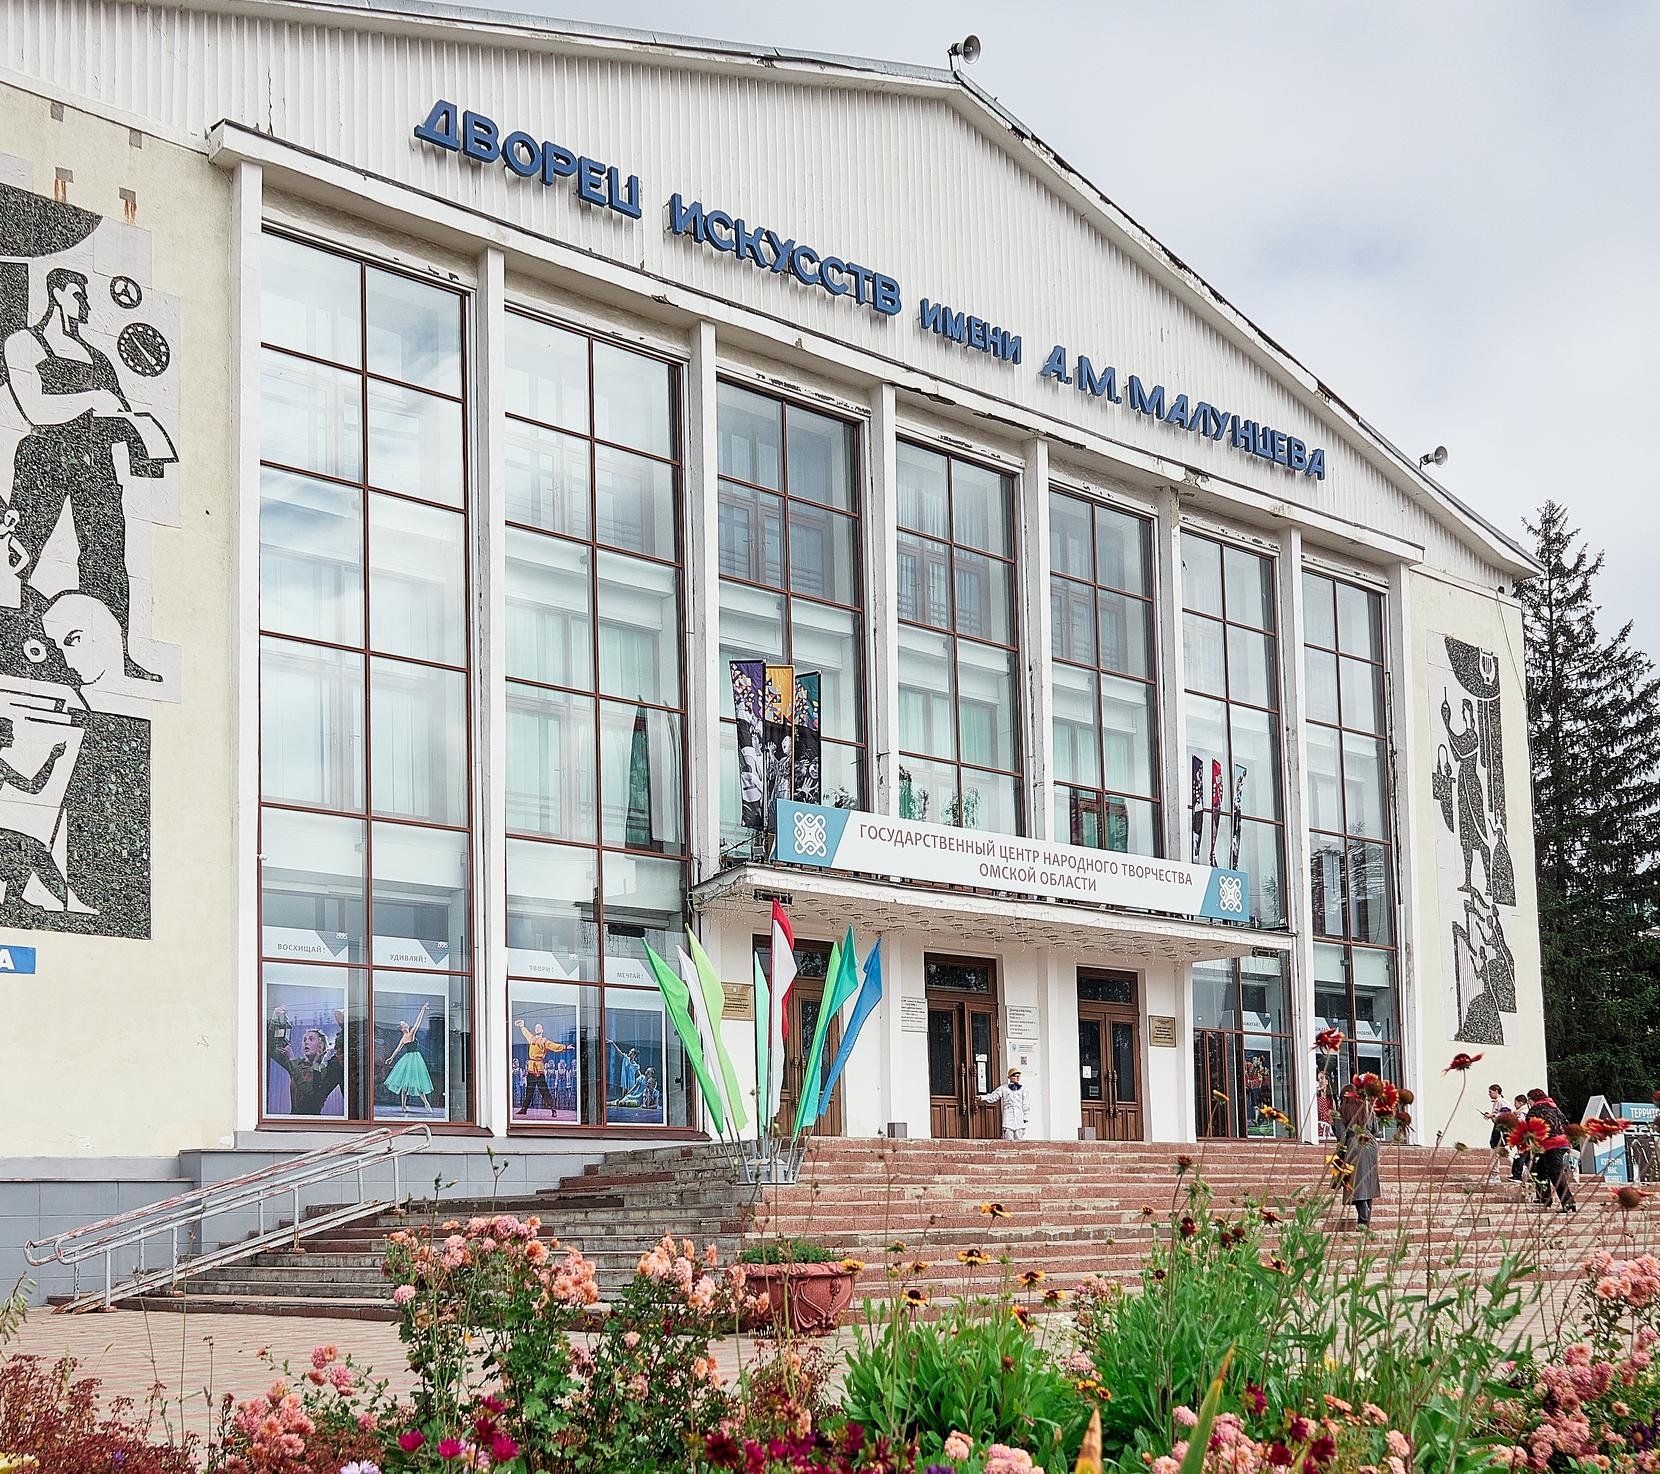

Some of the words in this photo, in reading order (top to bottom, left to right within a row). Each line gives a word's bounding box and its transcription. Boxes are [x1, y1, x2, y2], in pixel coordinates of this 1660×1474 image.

[414, 99, 642, 220] ДВОРЕЦ
[670, 193, 901, 316] ИСКУССТВ
[919, 297, 1022, 365] ИМЕНИ
[1128, 374, 1326, 480] МАЛУНЦЕВА
[860, 823, 996, 857] ГОСУДАРСТВЕННЫЙ
[999, 845, 1040, 863] ЦЕНТР
[1043, 851, 1119, 875] НАРОДНОГО
[1121, 863, 1193, 886] ТВОРЧЕСТВА
[979, 862, 1036, 883] ОМСКОЙ
[1040, 871, 1097, 891] ОБЛАСТИ
[277, 943, 326, 954] ВОСХИЩАЙ!
[389, 953, 427, 963] УДИВЛЯЙ!
[529, 964, 554, 973] ТВОРИ!
[616, 972, 644, 980] МЕЧТАЙ!
